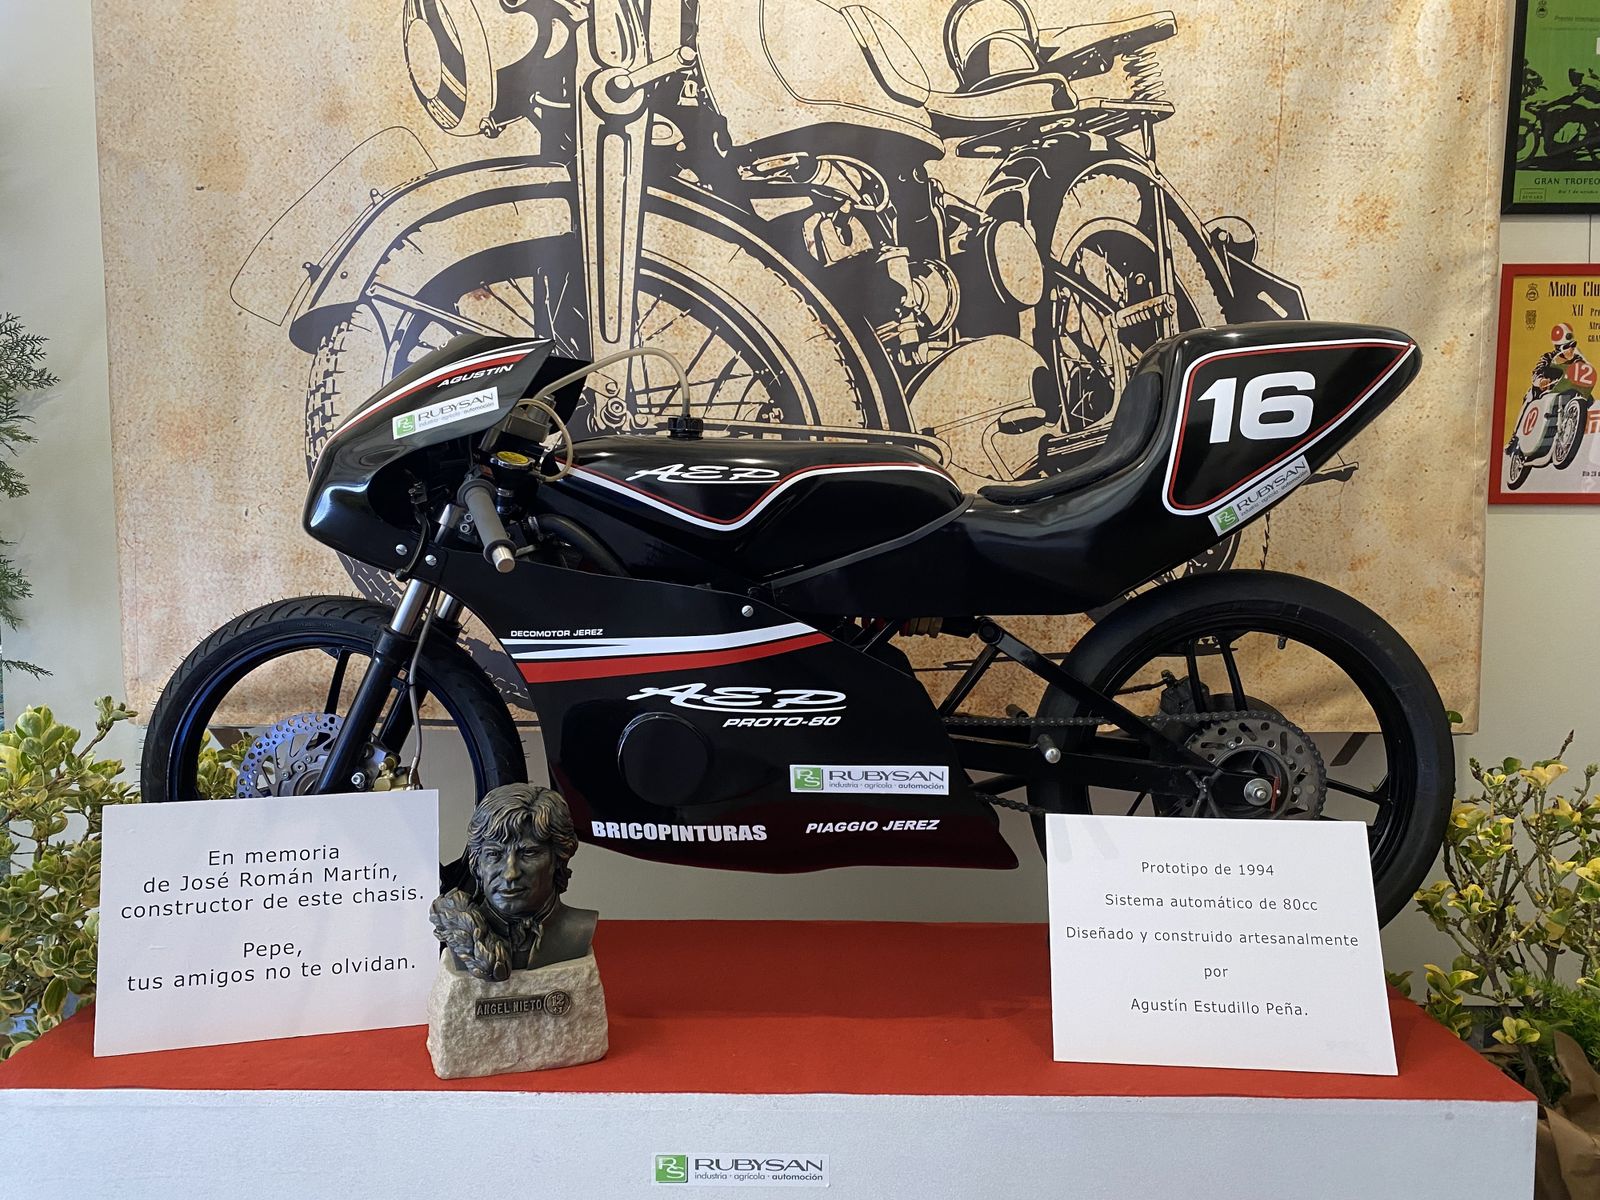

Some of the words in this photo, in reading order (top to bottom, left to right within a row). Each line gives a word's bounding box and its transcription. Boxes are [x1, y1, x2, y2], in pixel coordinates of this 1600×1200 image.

[1534, 177, 1559, 185] GRAN
[1564, 177, 1600, 185] TROFEO
[1548, 281, 1577, 297] Moto
[1571, 304, 1584, 317] XII
[437, 363, 515, 388] AGUSTIN
[1574, 362, 1594, 385] 12
[418, 393, 494, 421] RUBYSAN
[1197, 370, 1316, 444] 16
[625, 463, 781, 485] AEP
[1236, 461, 1306, 511] RUBYSAN
[510, 629, 571, 638] DECOMOTOR
[572, 628, 604, 637] JEREZ
[626, 683, 847, 713] AEP
[722, 715, 842, 729] PROTO-80
[828, 770, 945, 782] RUBYSAN
[898, 782, 945, 790] automoción
[591, 820, 768, 842] BRICOPINTURAS
[805, 821, 879, 834] PIAGGIO
[882, 819, 941, 831] JEREZ
[208, 850, 234, 866] En
[244, 844, 340, 864] memoria
[143, 876, 170, 894] de
[179, 871, 229, 892] José
[239, 867, 313, 888] Román
[323, 862, 398, 883] Martín,
[1141, 861, 1208, 877] Prototipo
[1214, 863, 1232, 876] de
[1238, 863, 1275, 877] 1994
[121, 897, 254, 919] constructor
[263, 893, 288, 910] de
[297, 891, 343, 908] este
[352, 885, 424, 904] chasis.
[1104, 893, 1164, 907] Sistema
[1170, 894, 1253, 910] automático
[1259, 897, 1277, 911] de
[1283, 898, 1318, 912] 80cc
[1066, 926, 1134, 941] Diseñado
[1139, 930, 1148, 944] y
[1154, 930, 1233, 944] construido
[1239, 932, 1359, 947] artesanalmente
[243, 941, 303, 960] Pepe,
[127, 975, 163, 992] tus
[173, 967, 255, 988] amigos
[265, 965, 291, 980] no
[301, 962, 322, 978] te
[331, 955, 416, 975] olvidan.
[1203, 966, 1229, 980] por
[513, 999, 542, 1012] NIETO
[1130, 998, 1188, 1014] Agustín
[1194, 1000, 1260, 1015] Estudillo
[1266, 1002, 1309, 1017] Peña.
[694, 1158, 823, 1172] RUBYSAN
[694, 1172, 728, 1180] industria
[733, 1172, 766, 1181] agrícola
[771, 1172, 823, 1181] automoción
